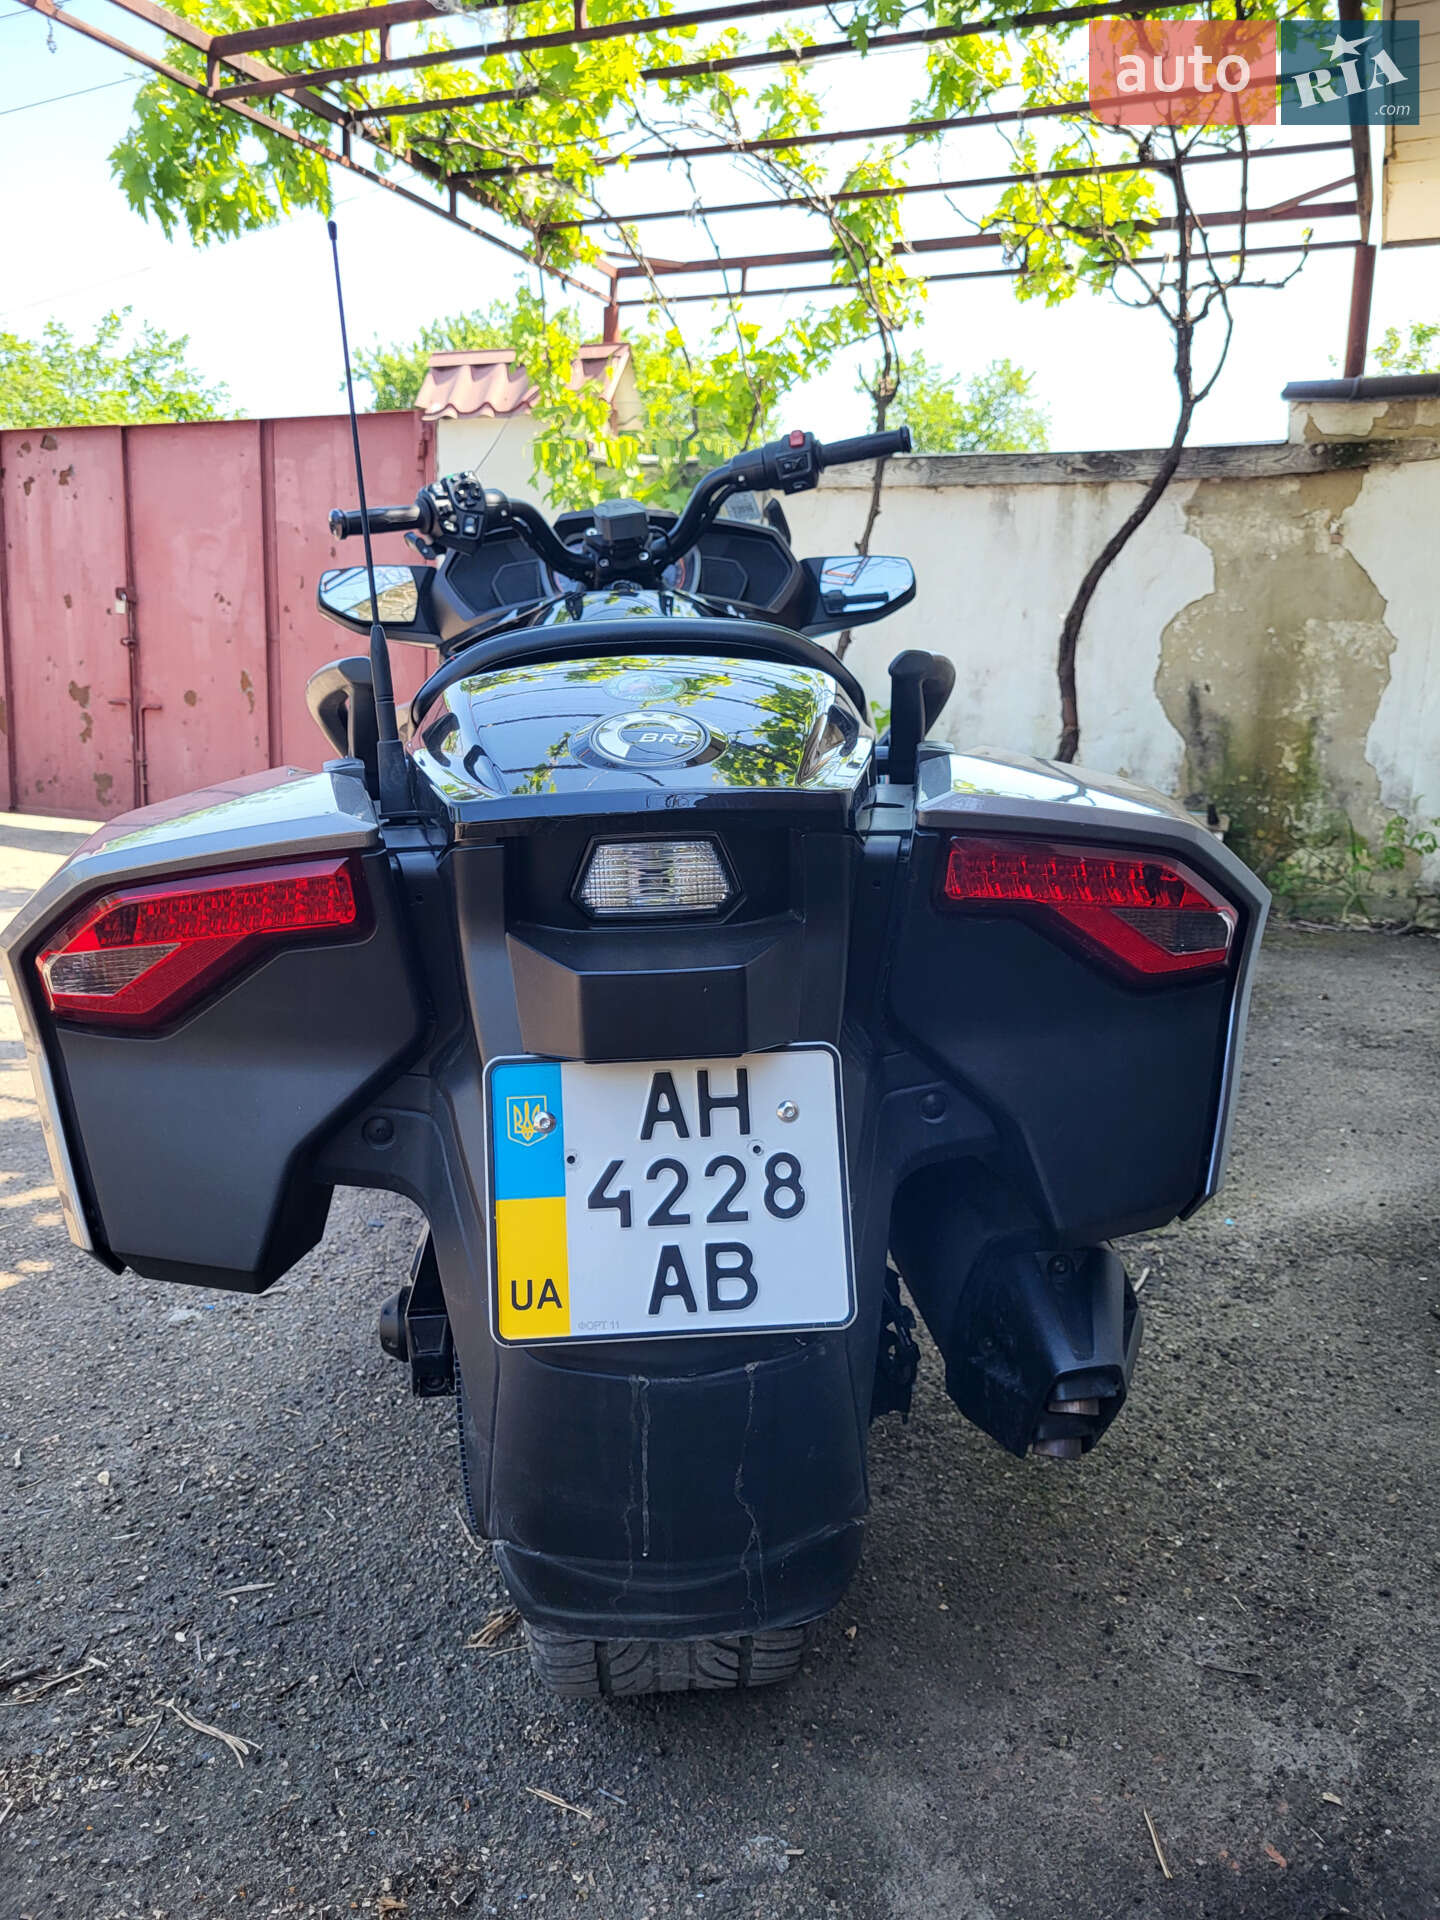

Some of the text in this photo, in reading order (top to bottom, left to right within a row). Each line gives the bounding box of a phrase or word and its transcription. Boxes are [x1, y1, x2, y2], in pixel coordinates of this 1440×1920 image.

[639, 732, 699, 744] BRP
[640, 1068, 751, 1140] AH
[587, 1152, 806, 1229] 4228
[511, 1279, 563, 1311] UA
[648, 1242, 758, 1315] AB
